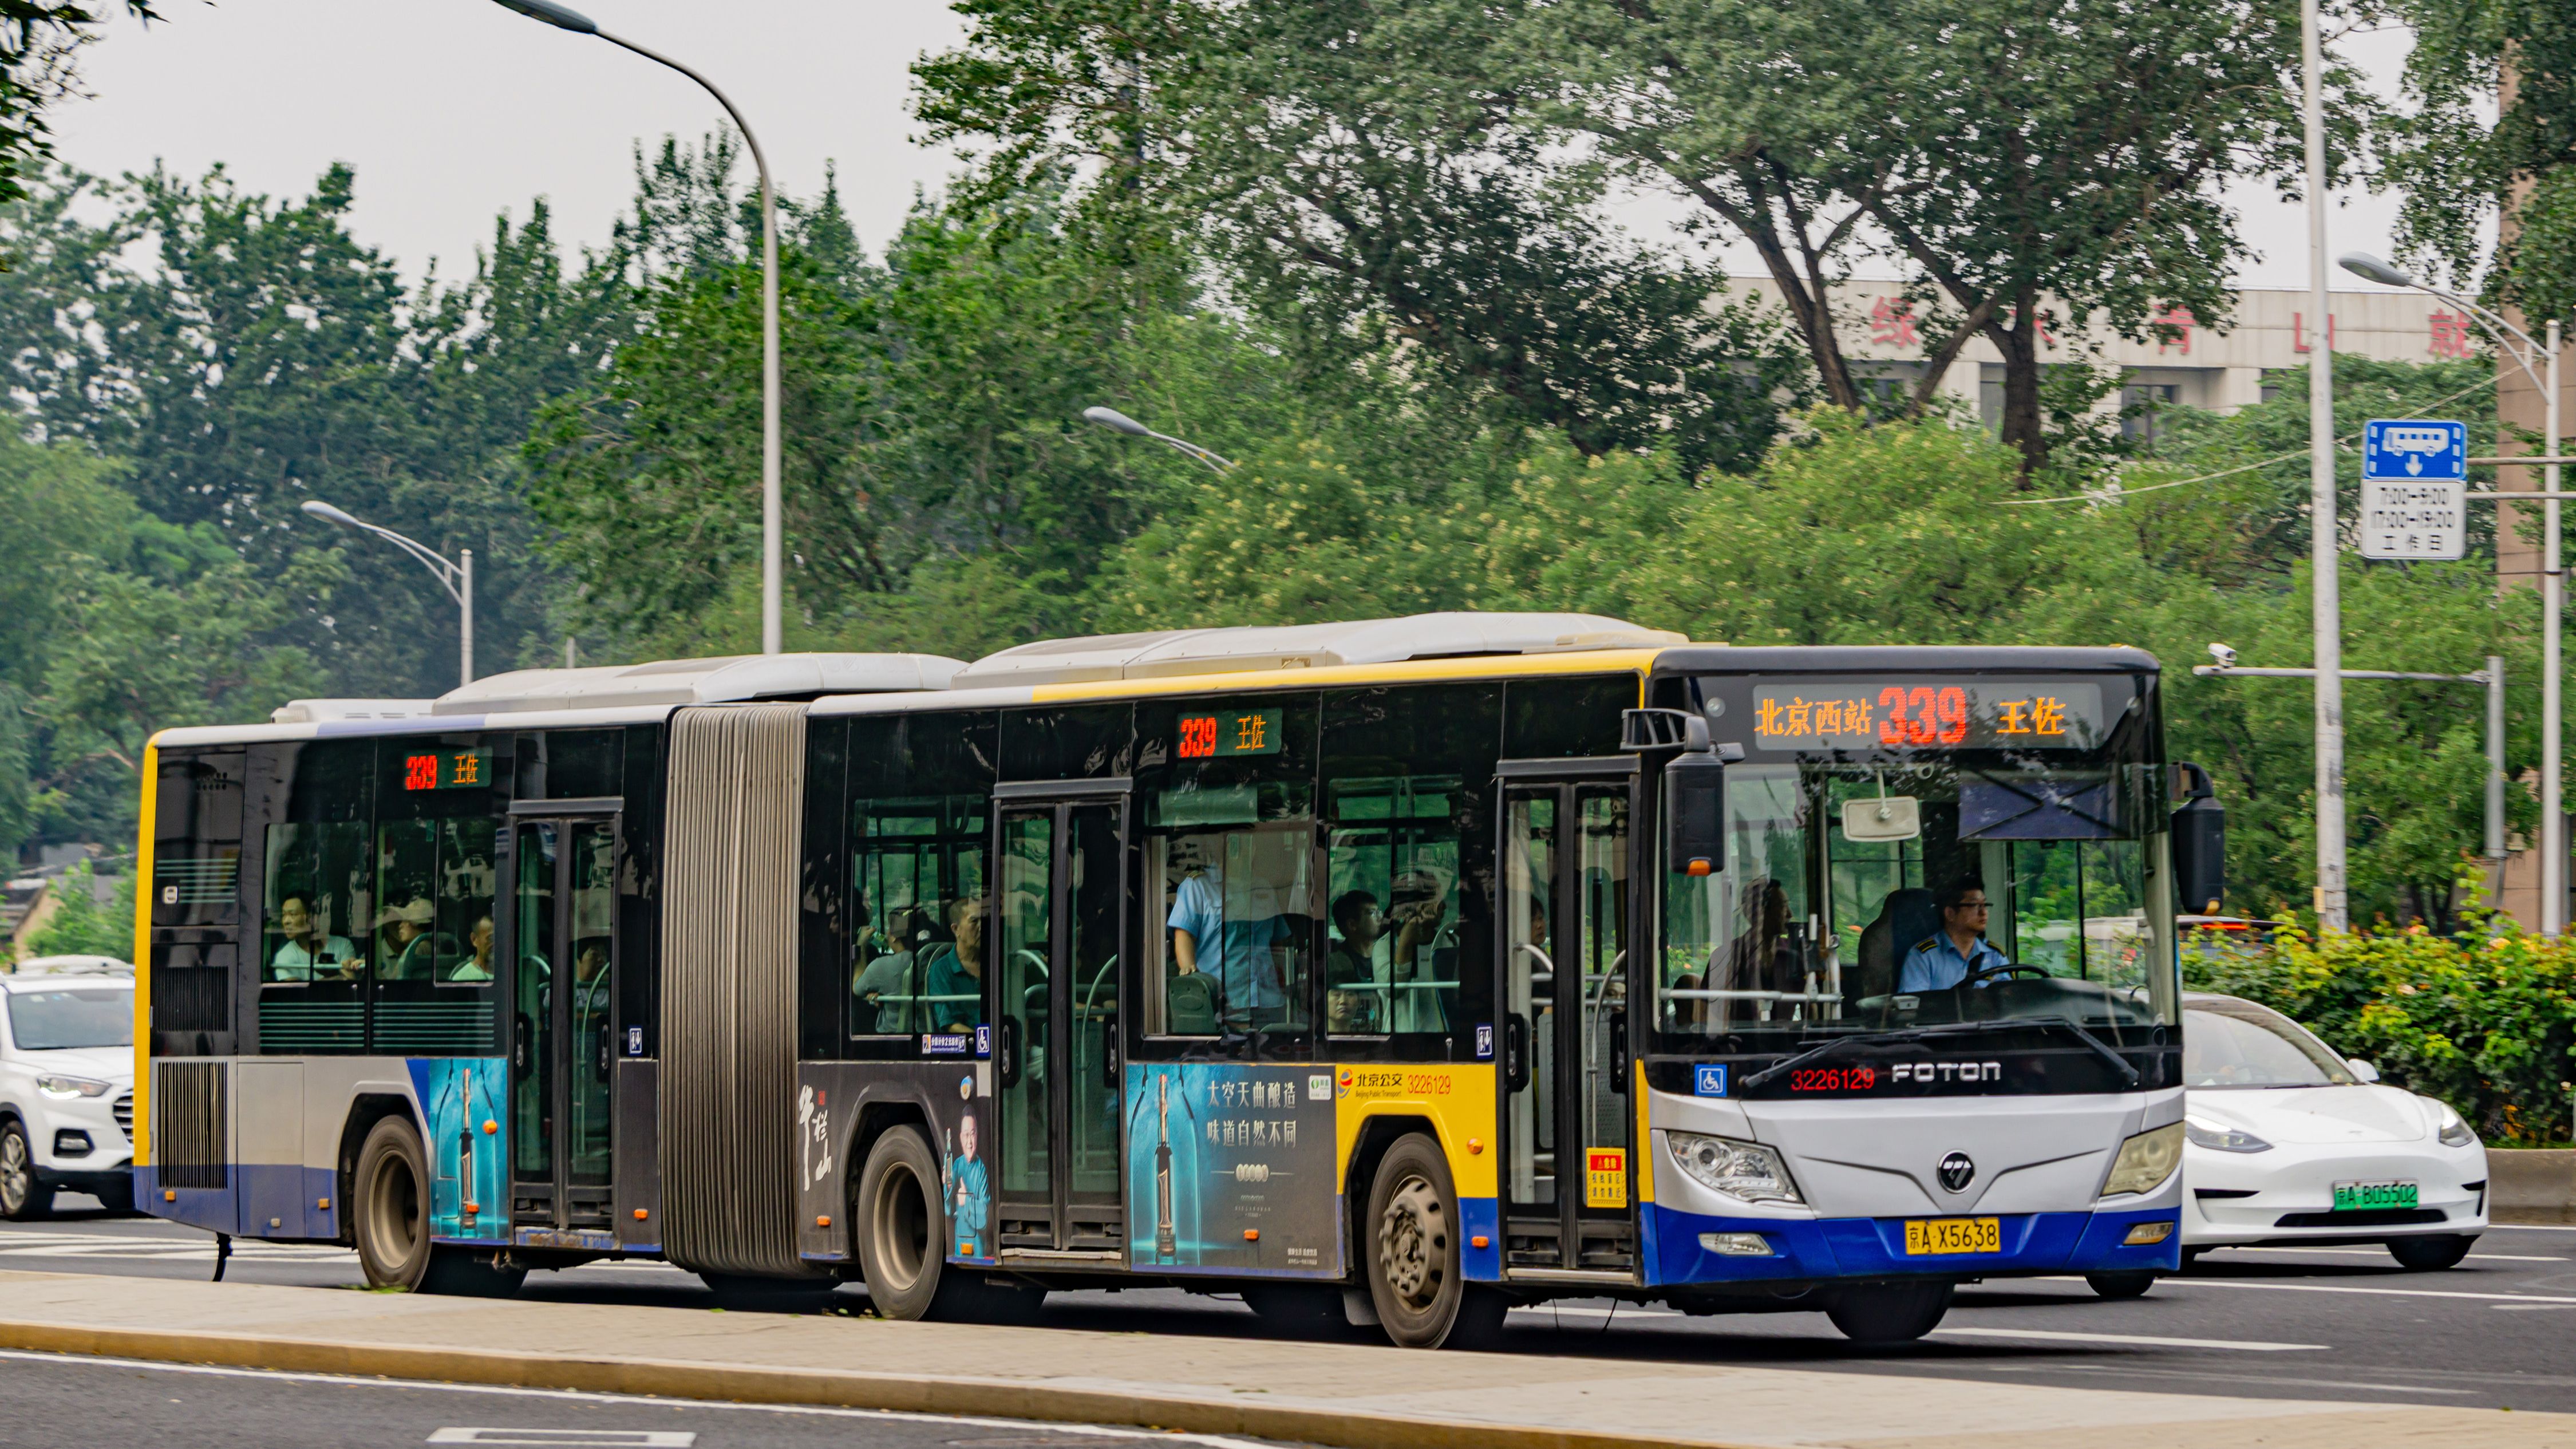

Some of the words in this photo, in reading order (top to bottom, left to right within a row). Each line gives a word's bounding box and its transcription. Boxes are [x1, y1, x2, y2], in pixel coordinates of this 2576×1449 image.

[2382, 534, 2443, 552] 工作日
[1755, 696, 1873, 737] 北京西站
[1878, 687, 1966, 745] 339
[1997, 696, 2067, 735] 王佐
[1180, 717, 1216, 757] 339
[1236, 714, 1266, 751] 王佐
[405, 755, 437, 791] 339
[453, 753, 479, 784] 王佐
[1357, 1073, 1402, 1087] 北京公交
[1791, 1068, 1875, 1091] 3226129
[1892, 1061, 2001, 1083] FOTON
[1356, 1090, 1369, 1099] Beijing
[1381, 1090, 1402, 1099] Transport
[1408, 1074, 1451, 1095] 3226129
[1207, 1119, 1297, 1148] 味道自然不同
